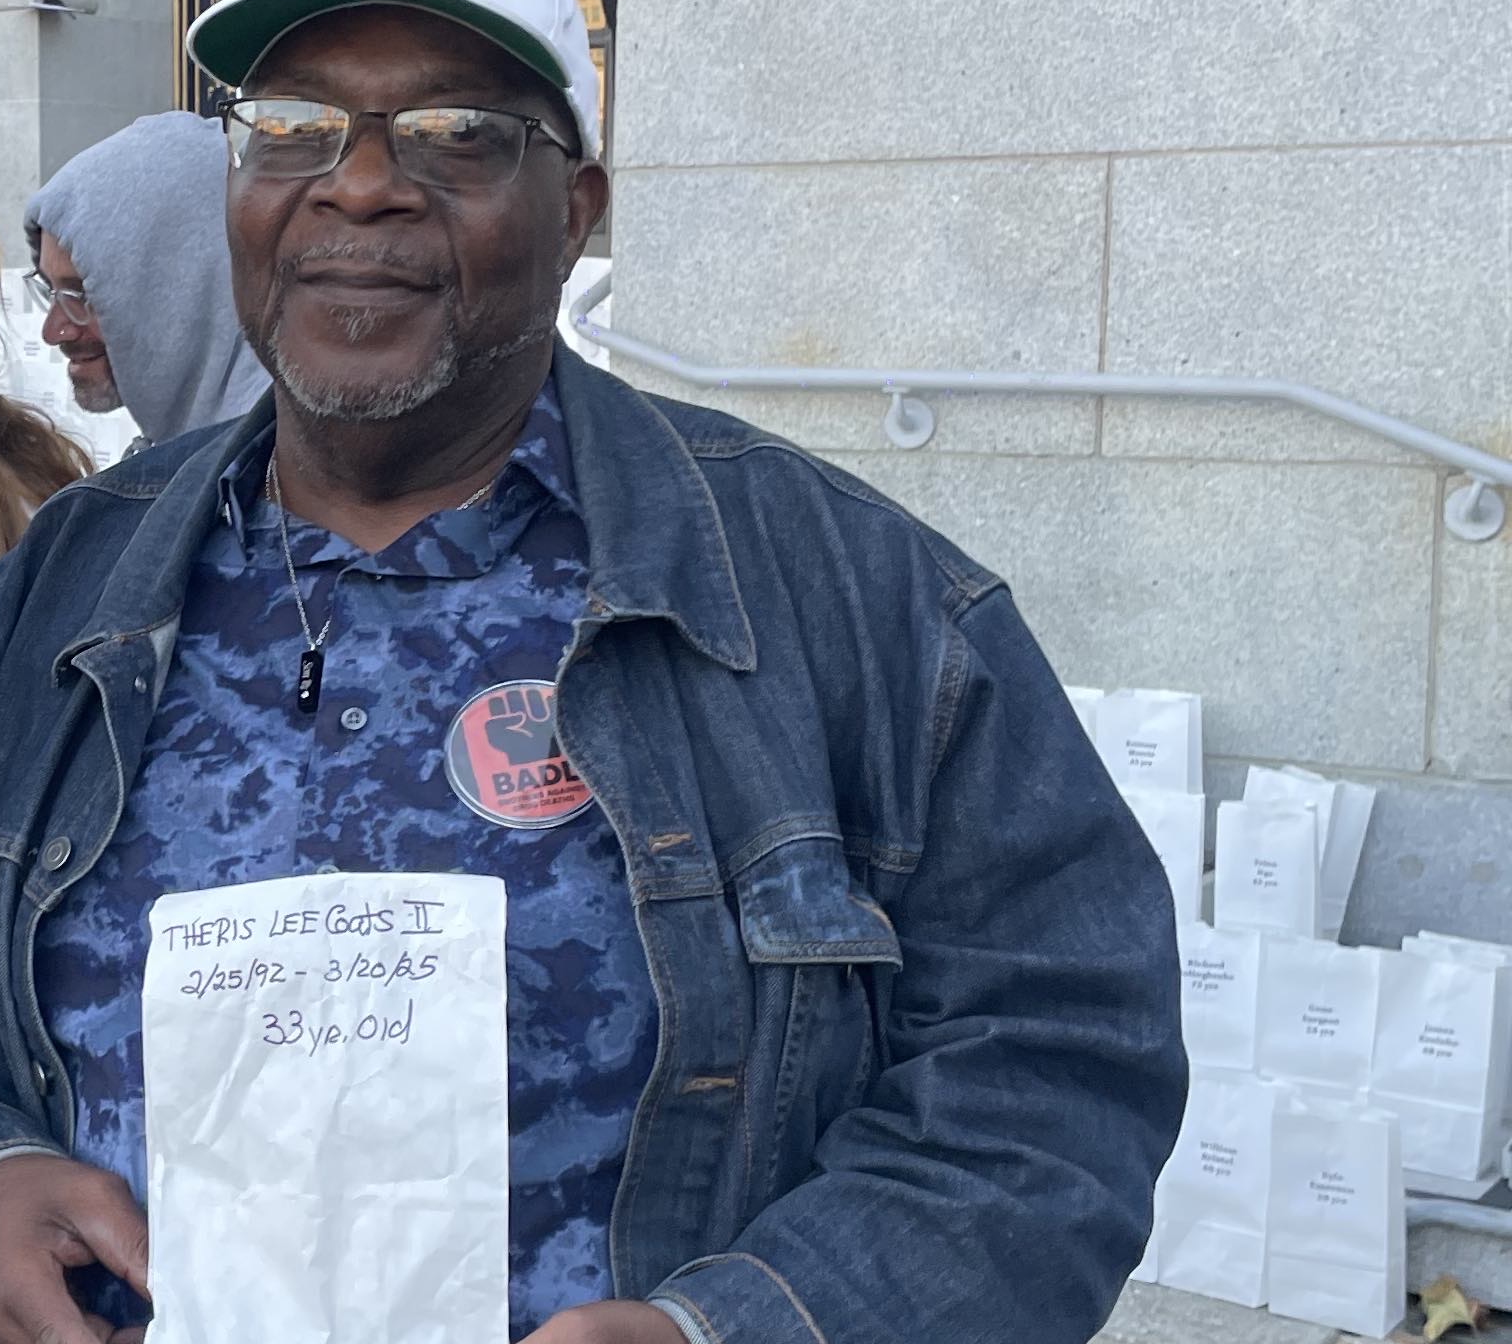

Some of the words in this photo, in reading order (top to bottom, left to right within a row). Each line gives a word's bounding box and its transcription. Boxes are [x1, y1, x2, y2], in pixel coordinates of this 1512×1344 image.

[163, 917, 256, 951] THERIS
[269, 911, 320, 939] LEE
[180, 958, 287, 999] 2/25/92
[323, 953, 439, 987] 3/20/25
